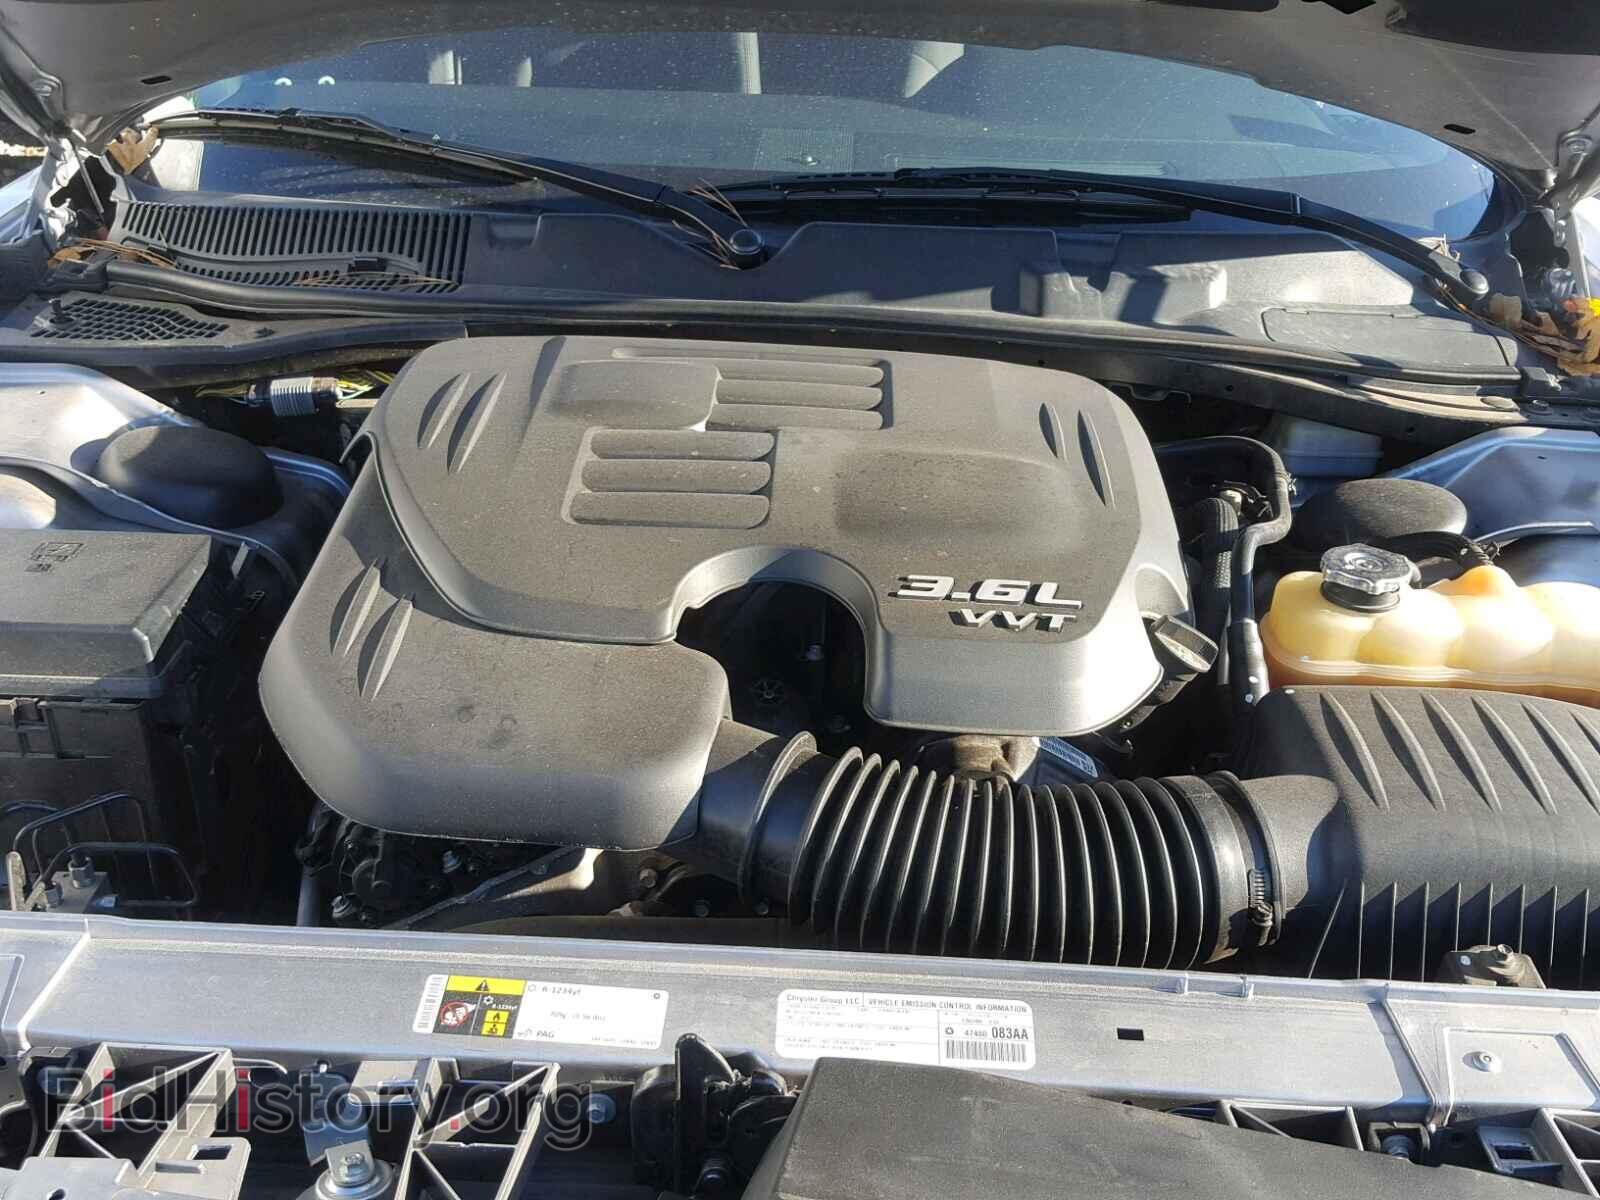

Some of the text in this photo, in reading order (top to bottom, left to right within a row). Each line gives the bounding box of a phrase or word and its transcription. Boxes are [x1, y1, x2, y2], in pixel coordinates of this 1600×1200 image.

[892, 574, 1083, 609] 3.6L
[951, 608, 1076, 632] VVT
[868, 998, 1028, 1013] VEHICLE EMISSION CONTROL INFORMATION
[991, 1026, 1029, 1040] 083AA
